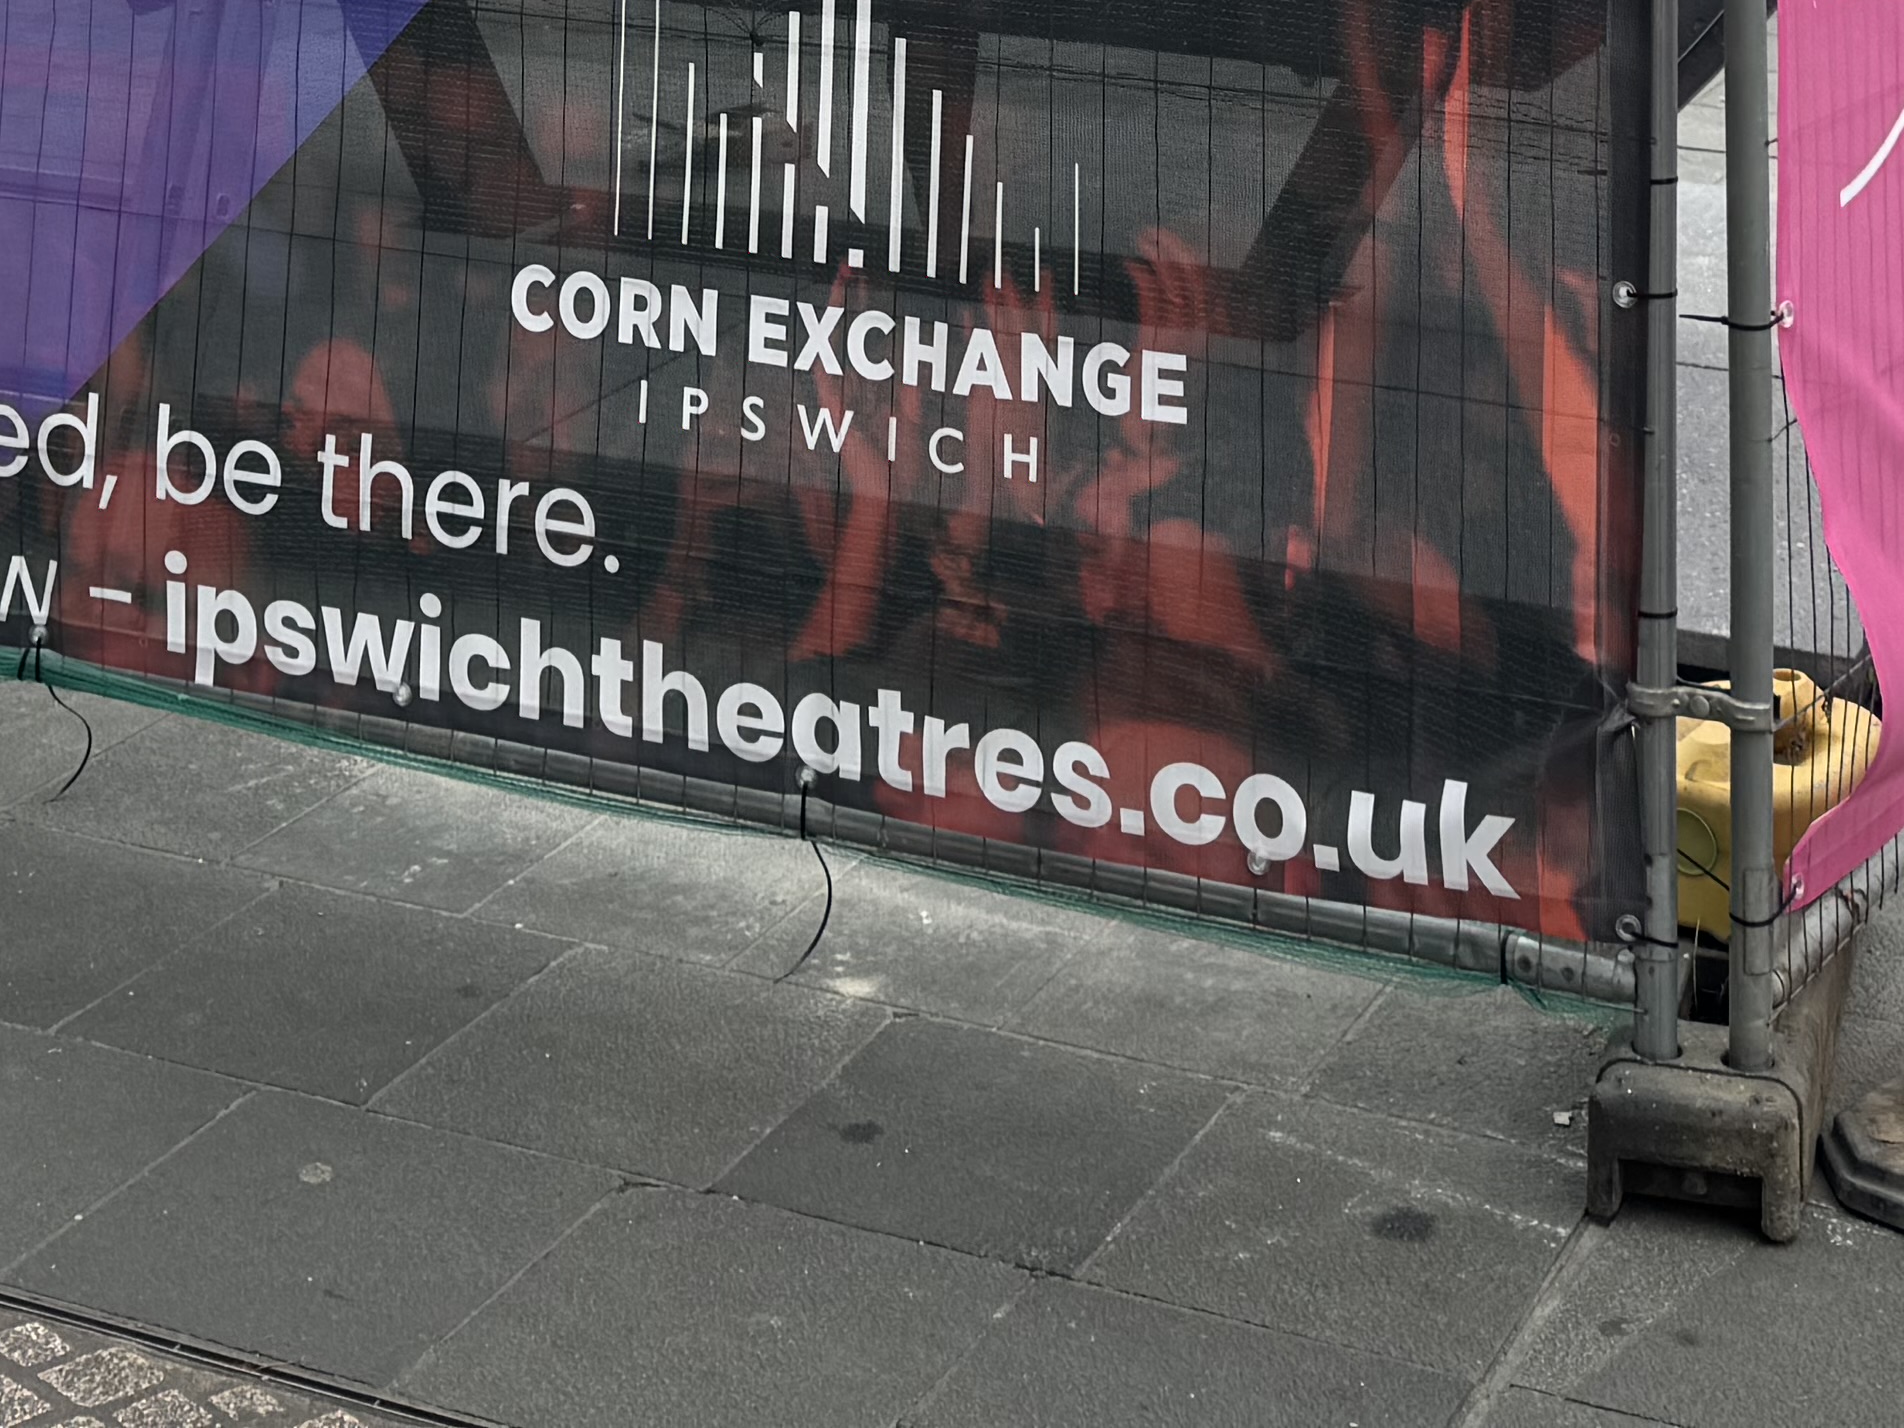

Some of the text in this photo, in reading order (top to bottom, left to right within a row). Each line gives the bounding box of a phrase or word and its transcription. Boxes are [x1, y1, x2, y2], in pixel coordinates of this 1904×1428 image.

[509, 261, 1191, 426] CORN EXCHANGE
[154, 400, 284, 517] be
[317, 429, 622, 579] there.
[636, 376, 1043, 485] IPSWICH
[163, 549, 1521, 905] ipswichtheatres.co.uk
